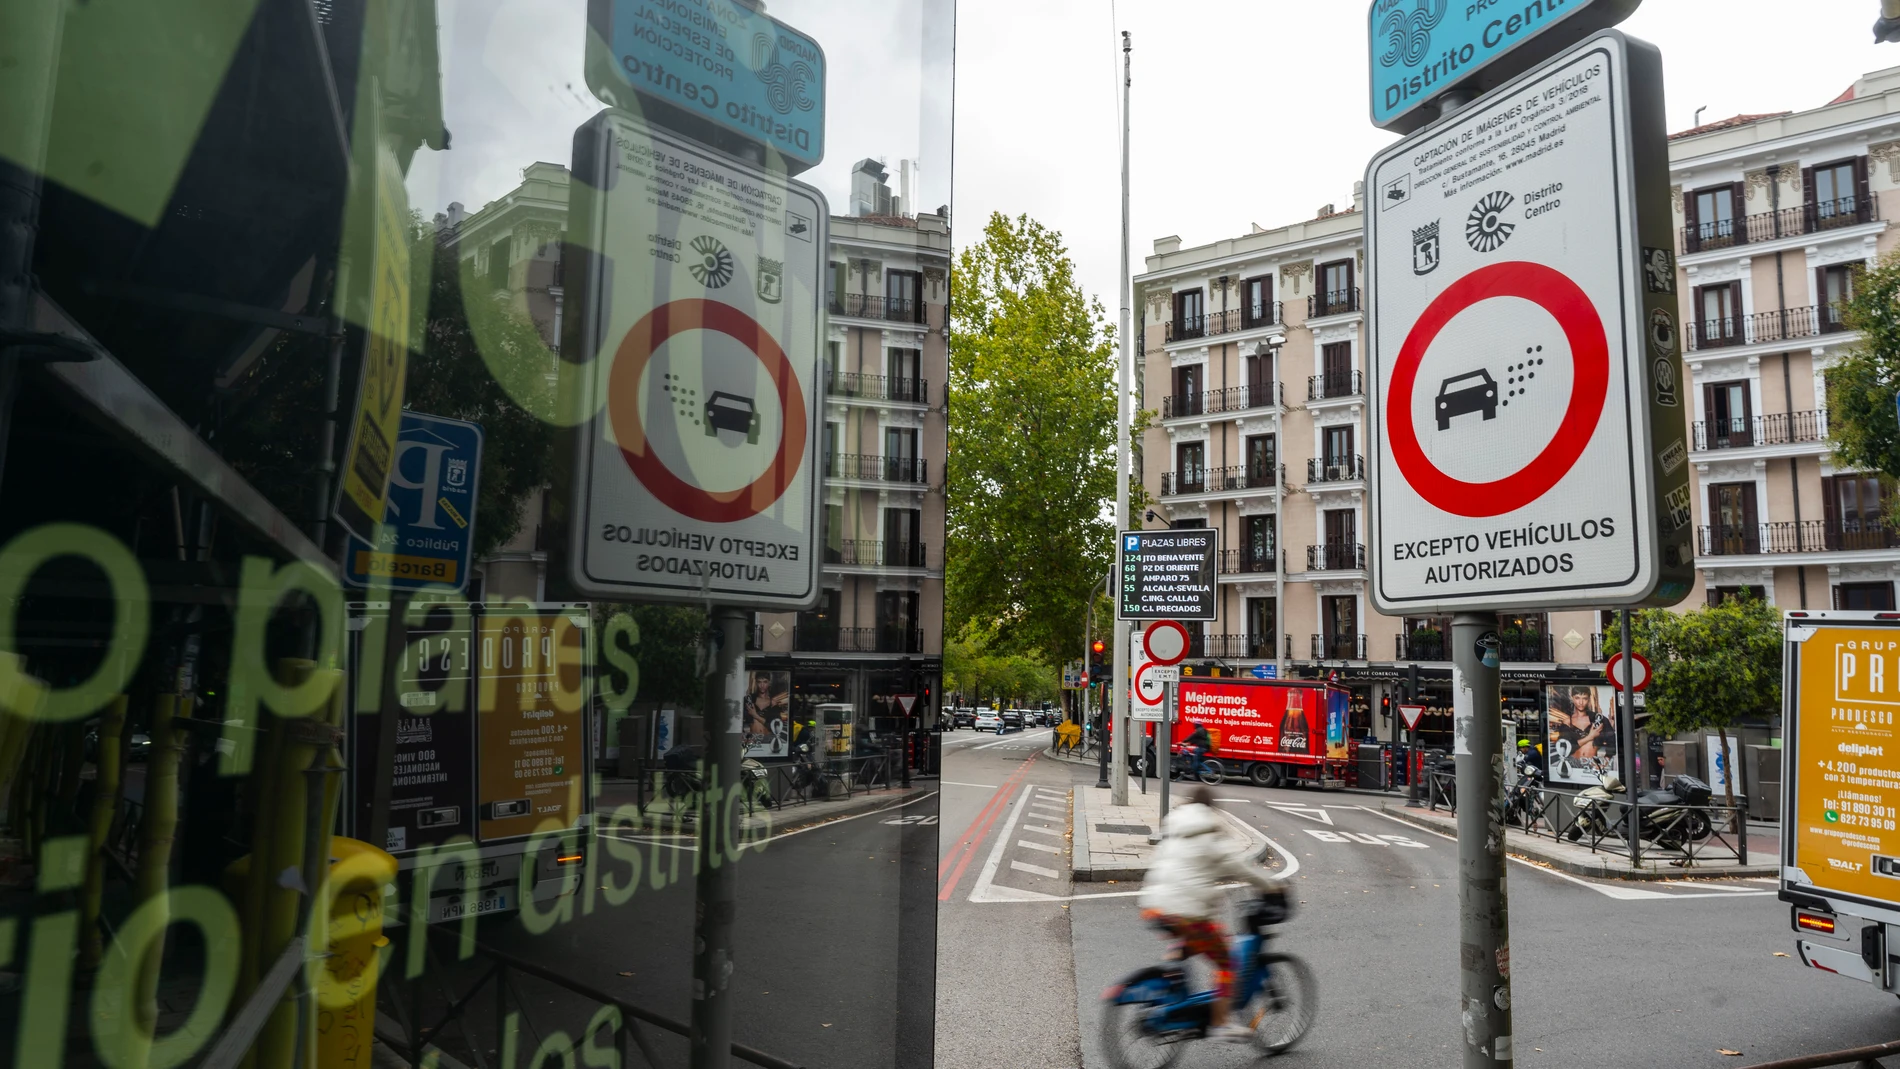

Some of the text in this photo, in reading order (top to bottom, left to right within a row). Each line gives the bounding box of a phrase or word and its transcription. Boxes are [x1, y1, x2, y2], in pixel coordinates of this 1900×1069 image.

[1385, 43, 1474, 111] Distrito
[1413, 65, 1601, 167] CAPTACIÓN DE IMÁGENES DE VEHÍCULOS
[1418, 154, 1453, 175] Tratamiento
[1455, 138, 1486, 158] conforme
[1494, 128, 1502, 137] la
[1504, 121, 1518, 134] Ley
[1520, 104, 1555, 124] Orgánica
[1558, 84, 1588, 106] 3/2018
[1443, 160, 1468, 176] GENERAL
[1533, 115, 1563, 132] CONTROL
[1565, 95, 1601, 117] AMBIENTAL
[1510, 139, 1536, 156] 28045
[1539, 124, 1567, 143] Madrid
[1443, 139, 1564, 199] Más información: www.madrid.es
[1523, 182, 1563, 205] Distrito
[1524, 198, 1561, 220] Centro
[1141, 538, 1174, 548] PLAZAS
[1176, 537, 1206, 547] LIBRES
[1393, 517, 1615, 561] EXCEPTO VEHÍCULOS
[1125, 554, 1204, 563] 124 JTO BENAVENTE
[1124, 564, 1136, 572] 68
[1142, 564, 1153, 572] PZ
[1154, 564, 1164, 572] DE
[1424, 552, 1574, 584] AUTORIZADOS
[1124, 574, 1190, 582] 54 AMPARO 75
[1124, 584, 1210, 592] 55 ALCALA-SEVILLA
[1124, 594, 1129, 602] 1
[1141, 594, 1165, 602] C.ING.
[1123, 604, 1140, 612] 150
[218, 525, 641, 777] planes
[1185, 691, 1248, 705] Mejoramos
[1185, 703, 1261, 718] sobre ruedas.
[1831, 707, 1893, 725] PRODESCO
[1223, 718, 1240, 726] bajas
[1241, 720, 1274, 728] emisiones.
[1837, 742, 1883, 757] deliplat
[1824, 773, 1838, 782] con
[1840, 774, 1845, 783] 3
[1859, 766, 1900, 779] productos
[1823, 798, 1895, 818] Tel: 91 890 30 11
[1840, 813, 1895, 831] 622 73 95 09
[1302, 829, 1430, 848] BUS
[306, 834, 483, 1008] en
